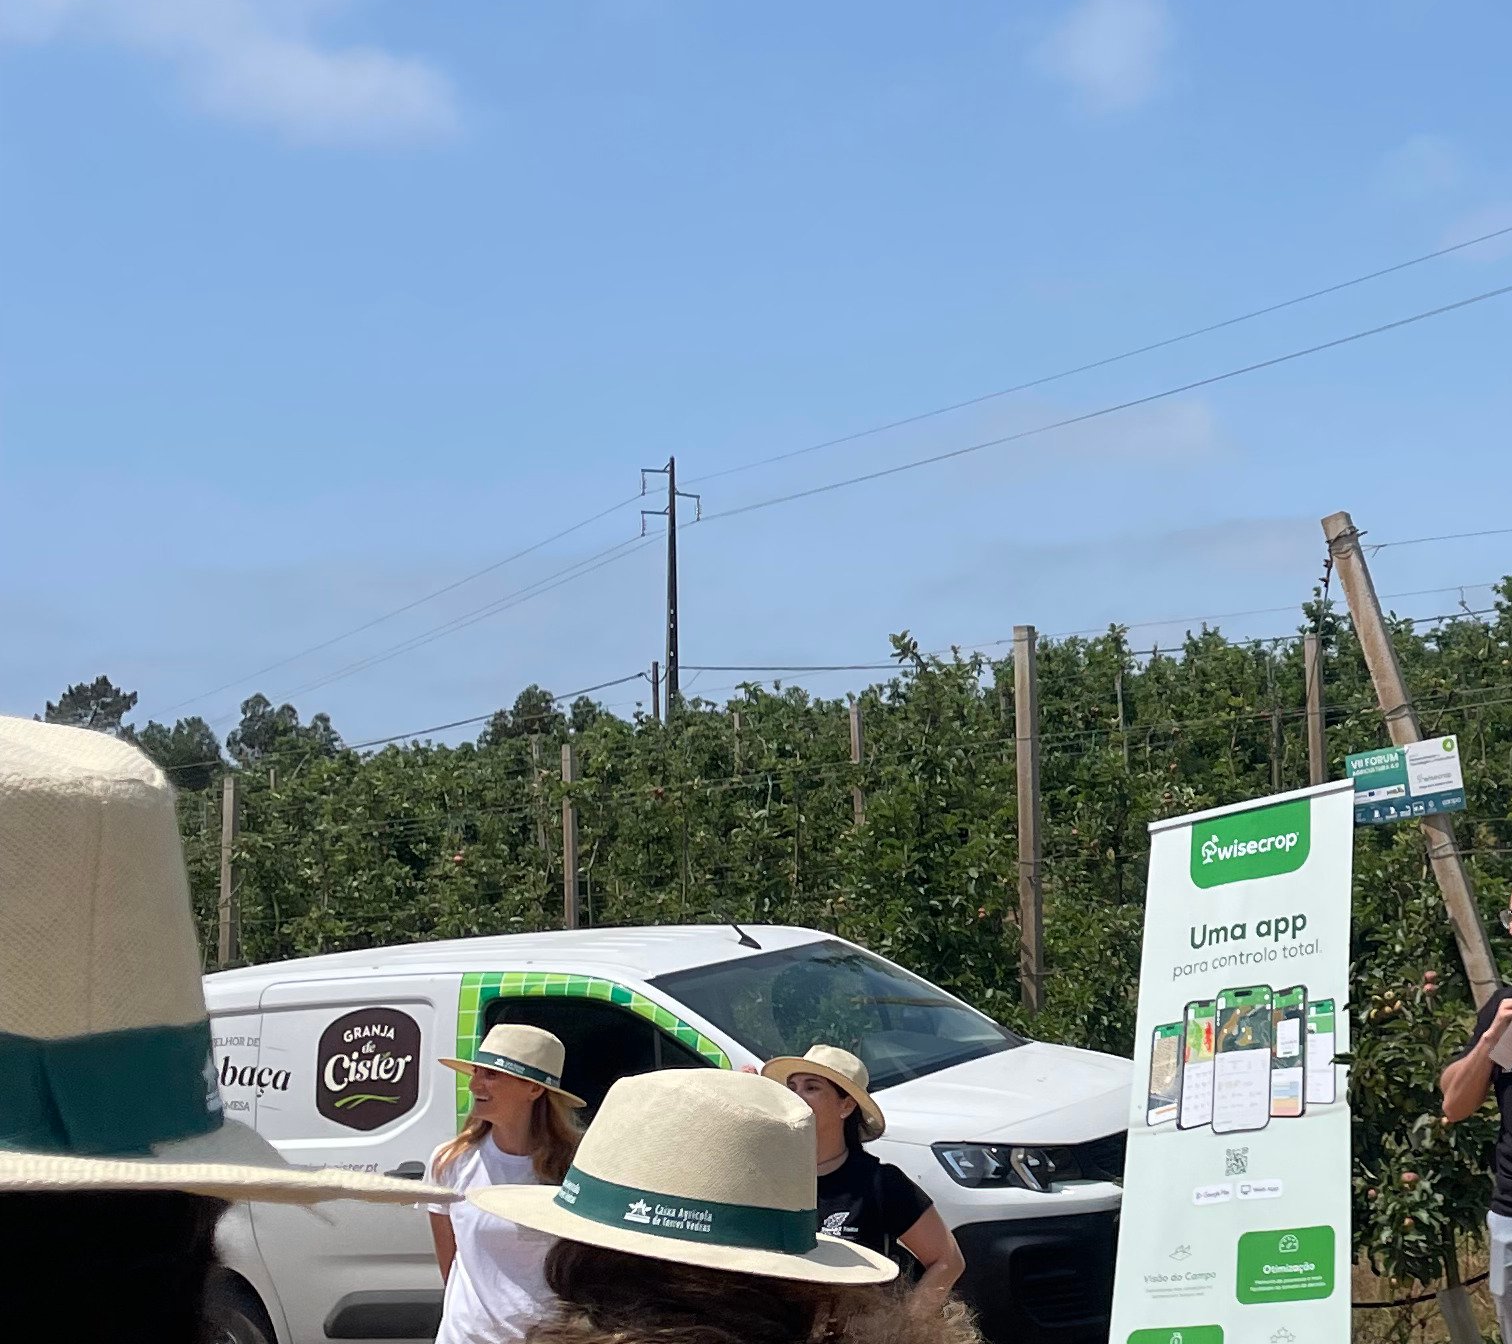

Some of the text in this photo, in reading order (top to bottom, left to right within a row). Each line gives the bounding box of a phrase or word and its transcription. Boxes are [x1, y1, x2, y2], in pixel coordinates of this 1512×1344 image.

[1217, 832, 1298, 861] wisecrop
[1190, 913, 1307, 950] Uma app
[1172, 938, 1323, 982] para controlo total.
[213, 1036, 246, 1048] ELHOR
[343, 1024, 395, 1043] GRANJA
[361, 1040, 376, 1054] de
[220, 1055, 291, 1097] baça
[323, 1051, 413, 1092] Cister
